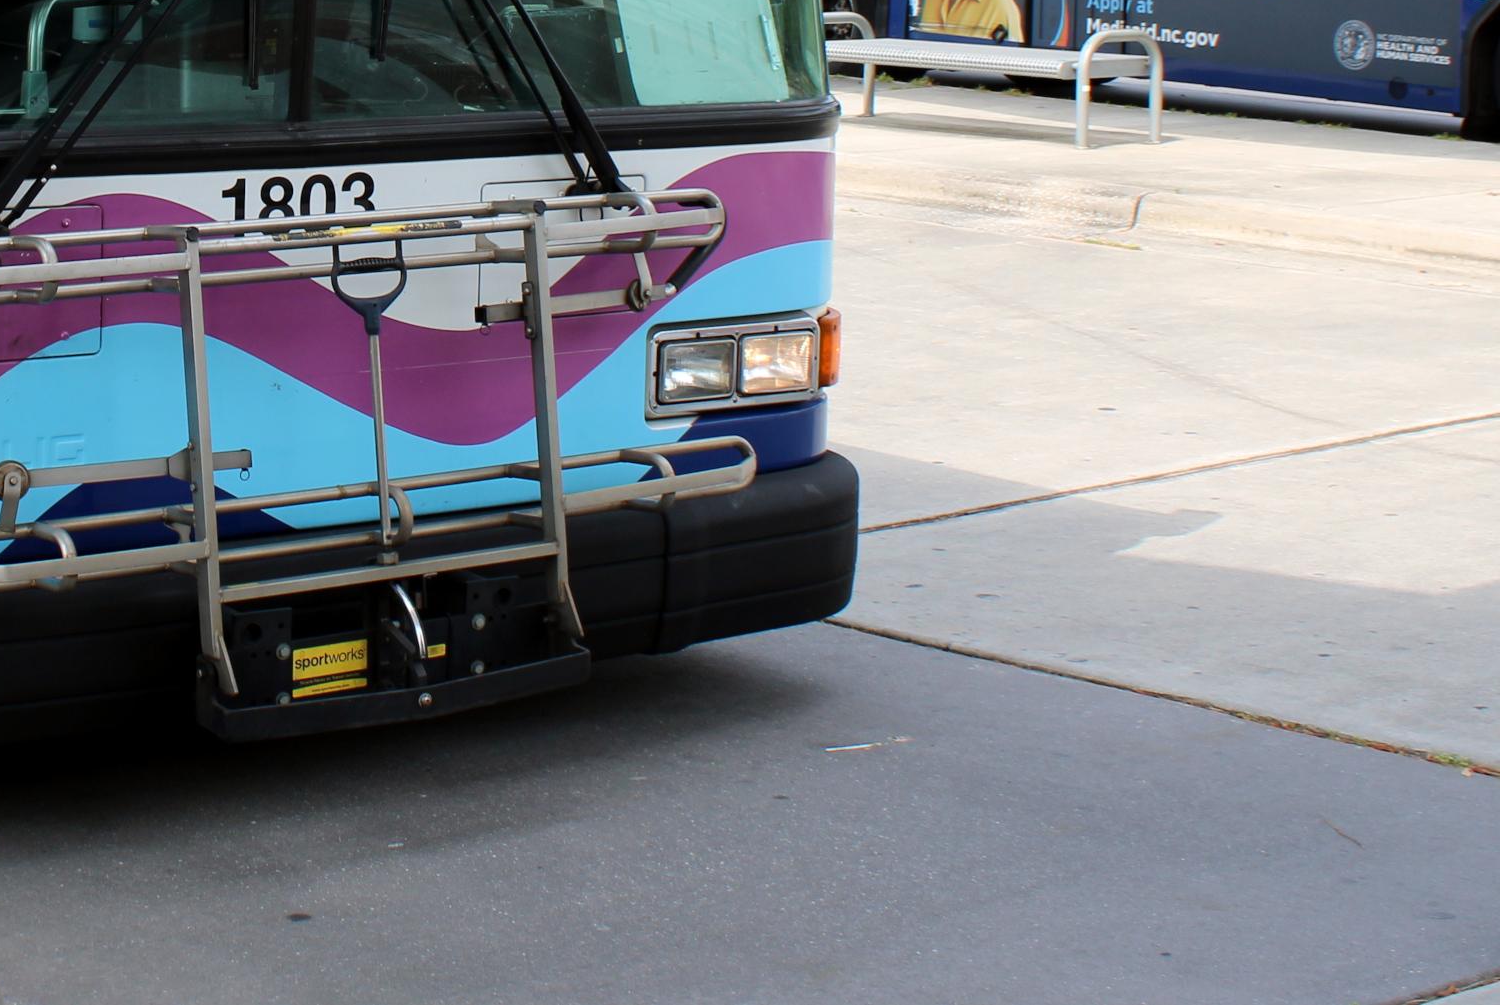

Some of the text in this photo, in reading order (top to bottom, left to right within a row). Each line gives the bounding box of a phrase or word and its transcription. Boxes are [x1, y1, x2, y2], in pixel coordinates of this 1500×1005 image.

[1376, 41, 1440, 54] HEALTH AND
[1376, 50, 1451, 65] HUMAN SERVICES
[220, 171, 376, 237] 1803
[295, 648, 366, 671] sportworks
